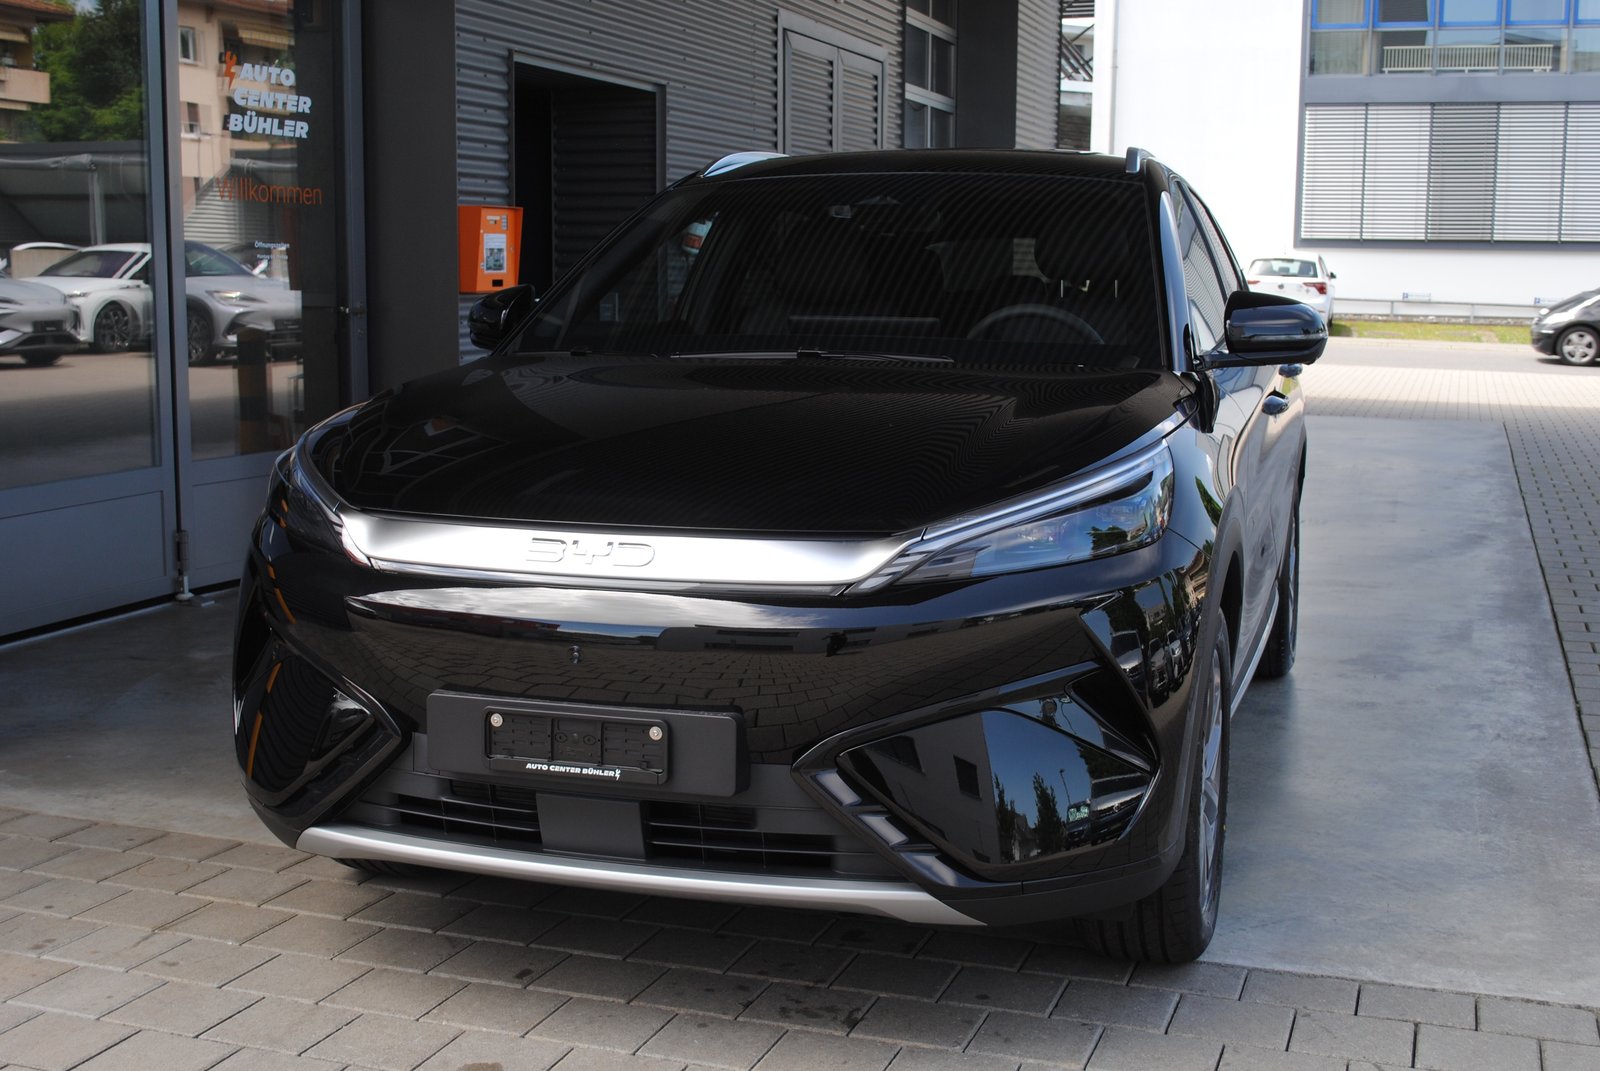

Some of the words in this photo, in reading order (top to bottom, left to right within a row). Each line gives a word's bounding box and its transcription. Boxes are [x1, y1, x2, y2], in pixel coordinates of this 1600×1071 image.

[240, 63, 296, 87] AUTO
[234, 87, 311, 113] CENTER
[229, 111, 309, 138] BÜHLER
[216, 178, 322, 206] Willkommen
[526, 537, 656, 567] BYD
[526, 763, 548, 771] AUTO
[549, 766, 581, 774] CENTER
[582, 767, 615, 777] BÜHLER
